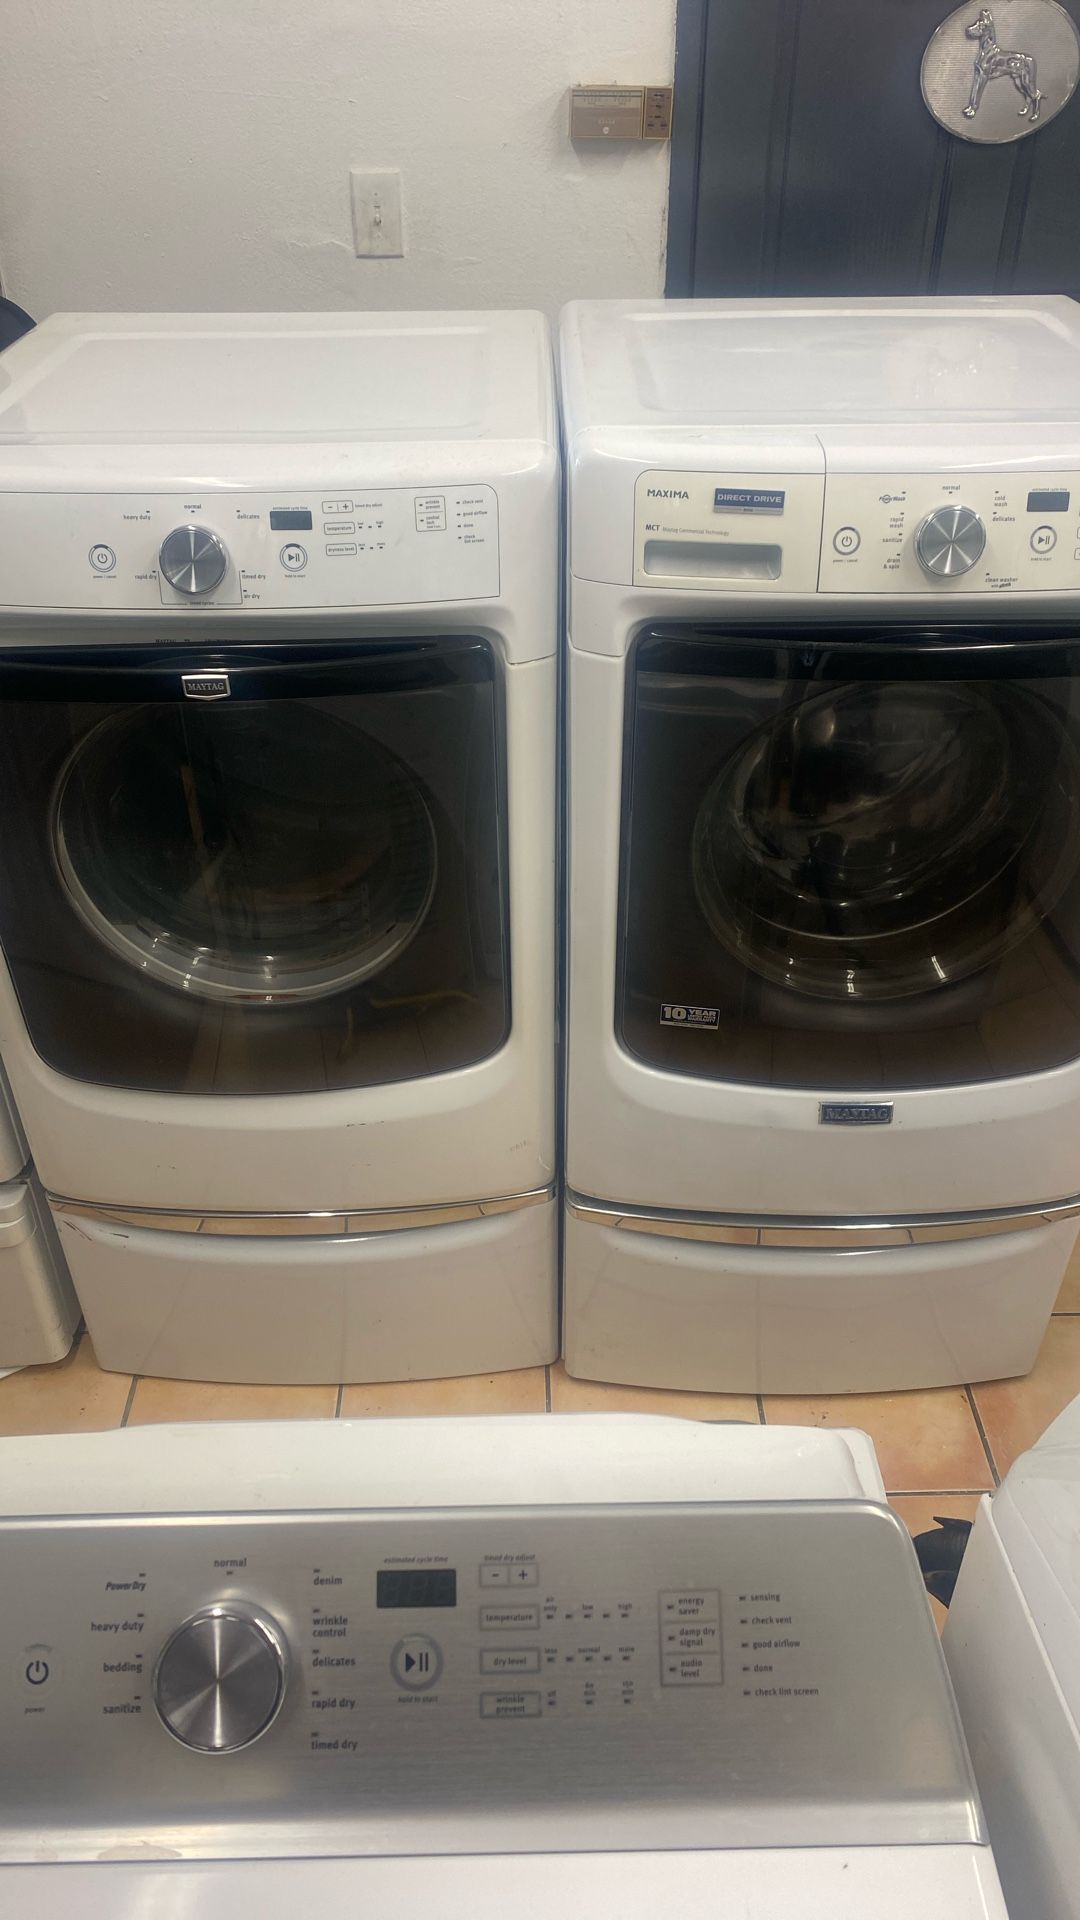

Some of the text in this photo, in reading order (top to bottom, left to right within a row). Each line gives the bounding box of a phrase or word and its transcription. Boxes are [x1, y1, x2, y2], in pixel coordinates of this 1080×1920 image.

[647, 488, 689, 500] MAXIMA
[717, 493, 782, 503] DIRECT DRIVE
[646, 524, 660, 532] MCT
[188, 682, 224, 690] MAYTAG
[664, 1006, 686, 1020] 10
[826, 1108, 888, 1120] MAYTAG
[214, 1558, 247, 1567] normal
[416, 1556, 432, 1564] cycle
[314, 1576, 342, 1585] denim
[106, 1581, 146, 1592] PowerDry
[751, 1594, 780, 1602] sensing
[313, 1616, 348, 1626] wrinkle
[486, 1614, 533, 1622] temperature
[752, 1616, 774, 1624] check
[91, 1621, 144, 1633] heavy duty
[680, 1627, 716, 1636] damp dry
[313, 1628, 346, 1638] control
[680, 1638, 703, 1648] signal
[753, 1640, 800, 1650] good airflow
[312, 1657, 356, 1667] delicates
[494, 1656, 526, 1666] dry level
[681, 1659, 702, 1668] audio
[104, 1662, 142, 1674] bedding
[754, 1664, 773, 1672] done
[681, 1670, 700, 1678] level
[755, 1688, 818, 1696] check lint screen
[103, 1704, 142, 1714] sanitize
[312, 1699, 356, 1710] rapid dry
[496, 1705, 526, 1714] prevent
[312, 1740, 358, 1750] timed dry
